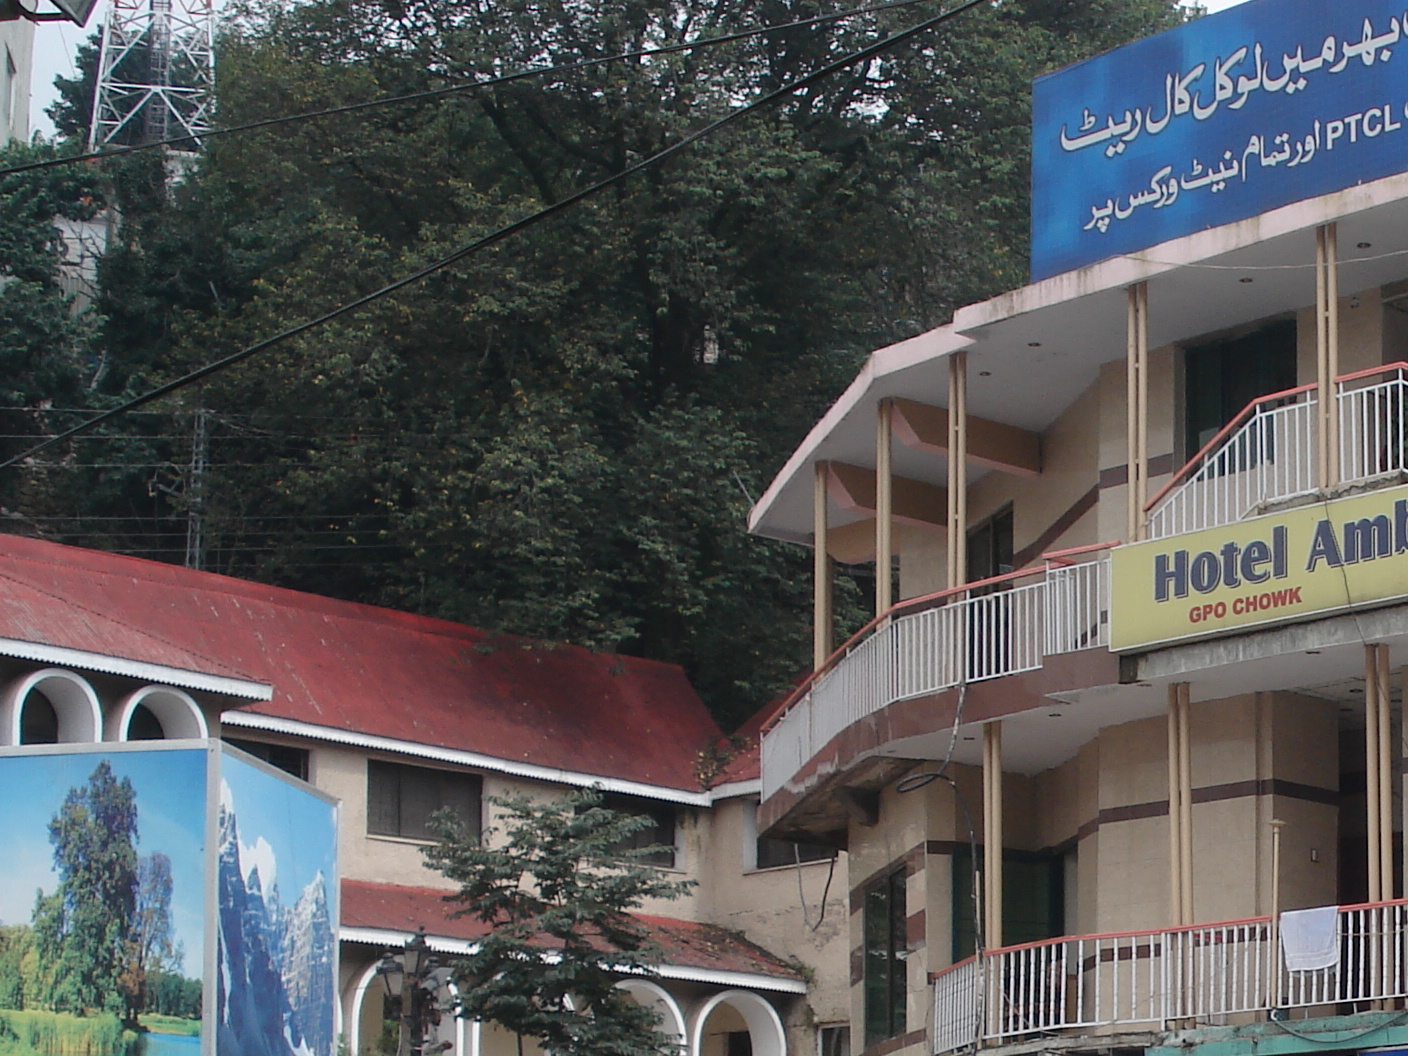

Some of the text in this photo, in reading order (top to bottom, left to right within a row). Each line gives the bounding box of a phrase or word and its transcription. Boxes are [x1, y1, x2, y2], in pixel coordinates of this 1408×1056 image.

[1192, 43, 1263, 119] لوکل
[1263, 34, 1335, 94] میں
[1145, 63, 1206, 134] کال
[1059, 106, 1143, 158] ریٹ
[1286, 119, 1321, 168] اور
[1325, 103, 1401, 150] PTCL
[1180, 149, 1240, 193] نیٹ
[1241, 131, 1291, 182] تمام
[1083, 192, 1114, 233] پر
[1154, 524, 1288, 603] Hotel
[1189, 585, 1303, 624] GPO CHOWK
